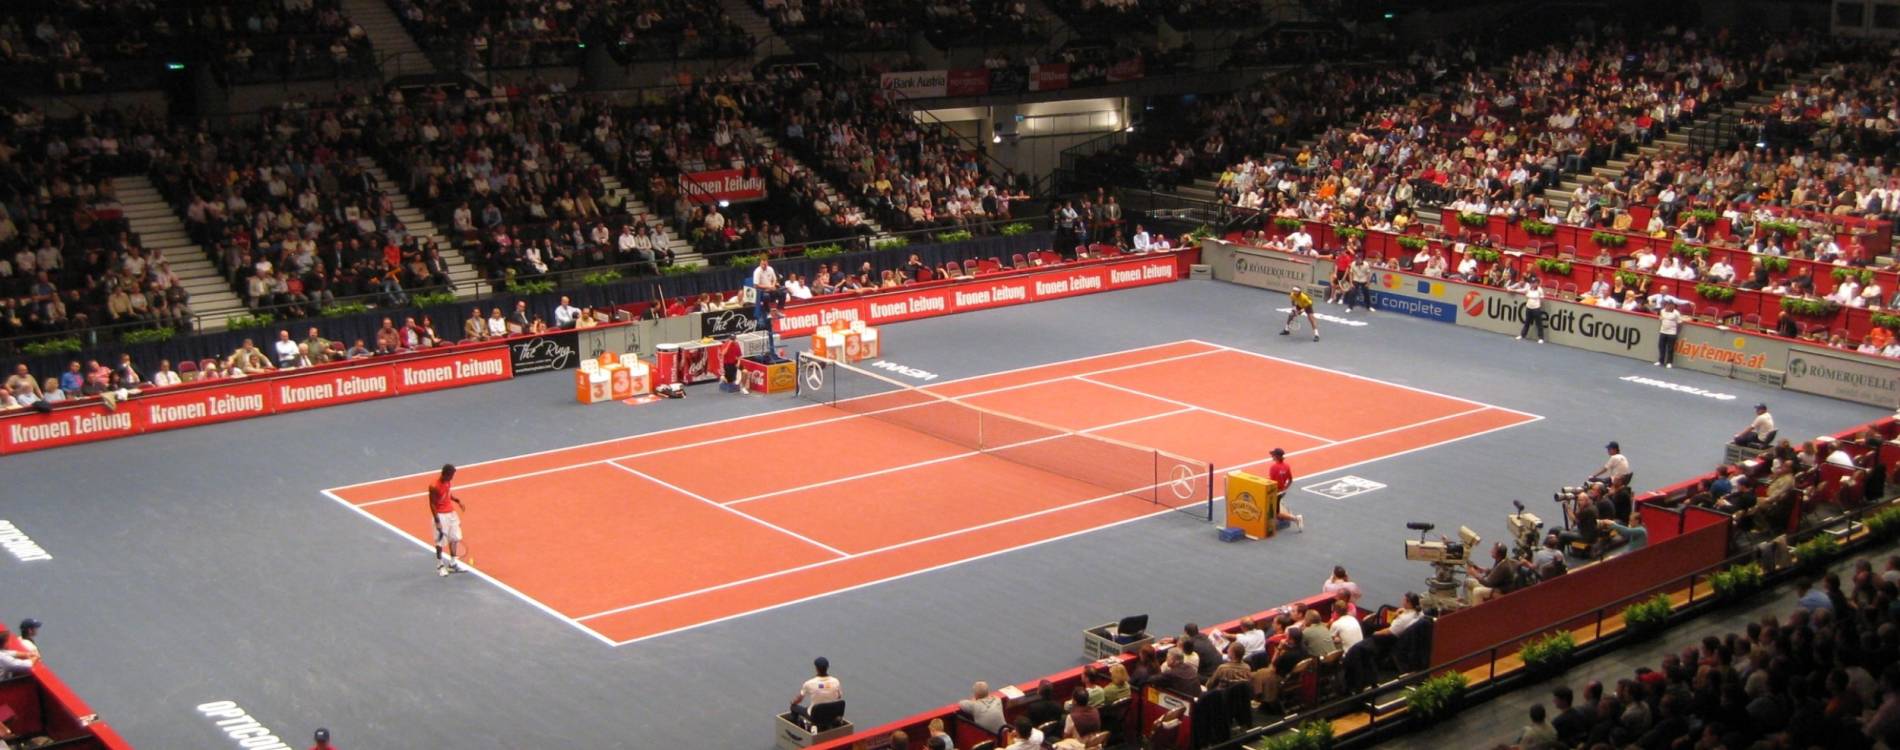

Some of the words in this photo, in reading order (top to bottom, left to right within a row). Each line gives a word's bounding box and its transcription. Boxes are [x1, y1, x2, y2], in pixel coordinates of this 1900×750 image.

[1035, 280, 1068, 295] Kronen
[1070, 274, 1101, 289] Zeitung
[1111, 269, 1141, 283] Kronen
[1142, 264, 1172, 279] Zeitung
[870, 301, 907, 318] Kronen
[909, 296, 945, 314] Zeitung
[955, 290, 991, 307] Kronen
[992, 285, 1026, 300] Zeitung
[1382, 297, 1442, 316] complete
[780, 313, 818, 331] Kronen
[1487, 296, 1575, 334] UniCedit
[1579, 313, 1641, 349] Group
[403, 366, 453, 386] Kronen
[455, 358, 503, 377] Zeitung
[281, 384, 333, 405] Kronen
[336, 375, 387, 395] Zeitung
[594, 384, 605, 399] 3
[151, 403, 206, 425] Kronen
[208, 393, 264, 416] Zeitung
[11, 421, 71, 444] Kronen
[74, 411, 132, 435] Zeitung
